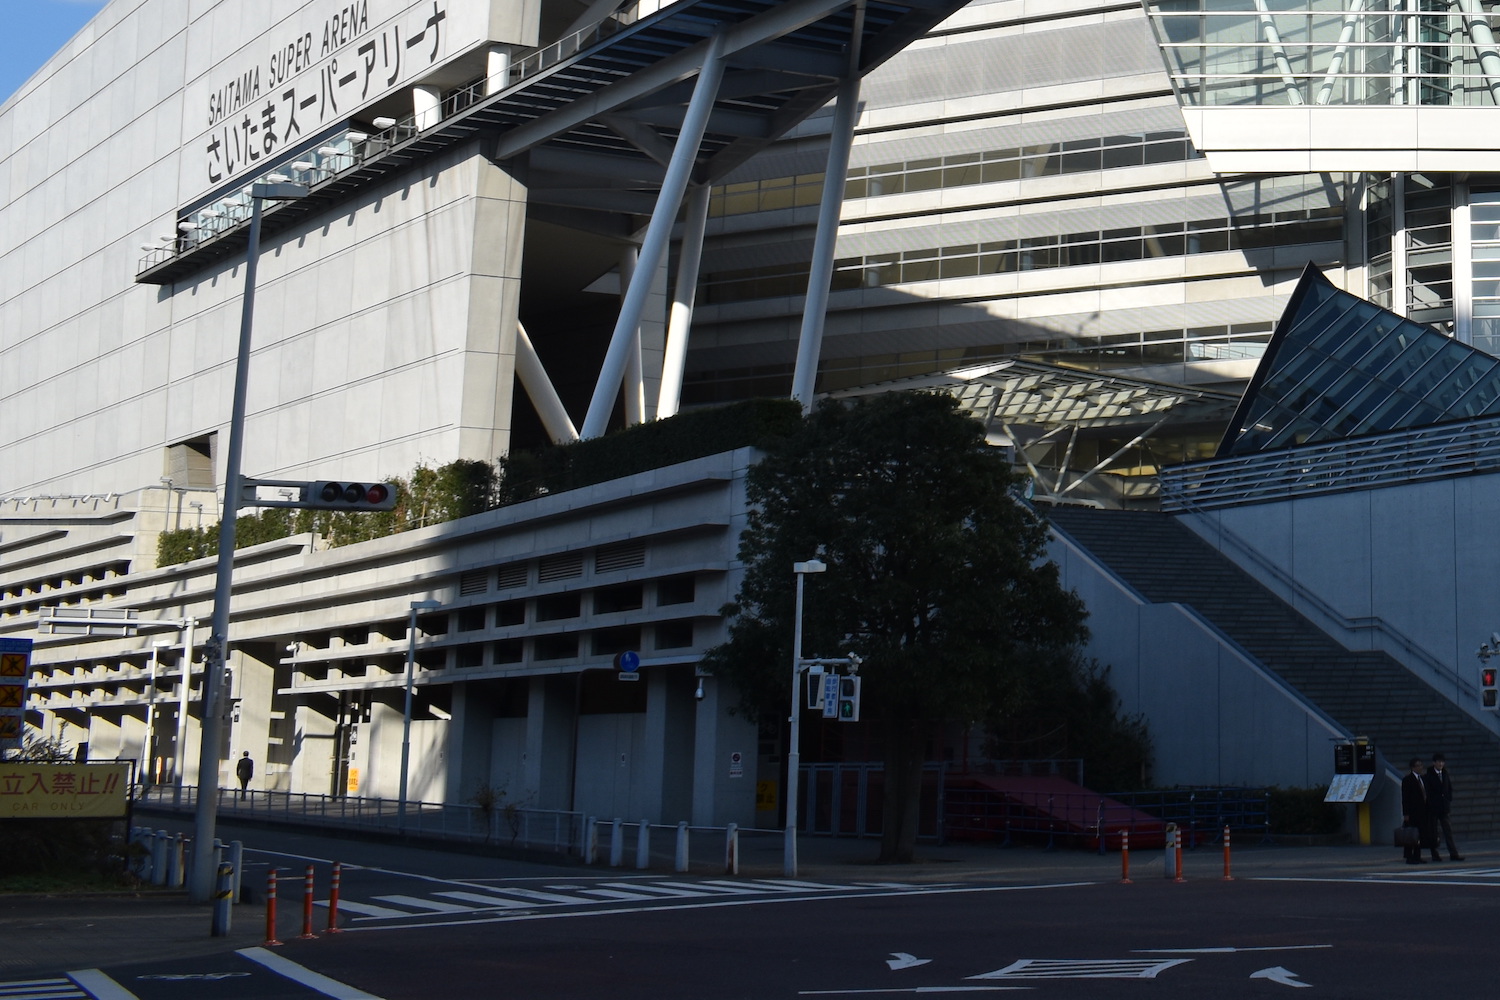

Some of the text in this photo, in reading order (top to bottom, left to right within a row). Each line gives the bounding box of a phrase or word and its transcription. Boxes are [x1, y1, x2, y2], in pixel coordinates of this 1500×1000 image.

[207, 1, 446, 184] さいたまスーパーアリーナ
[208, 65, 260, 126] SAITAMA
[269, 32, 312, 89] SUPER
